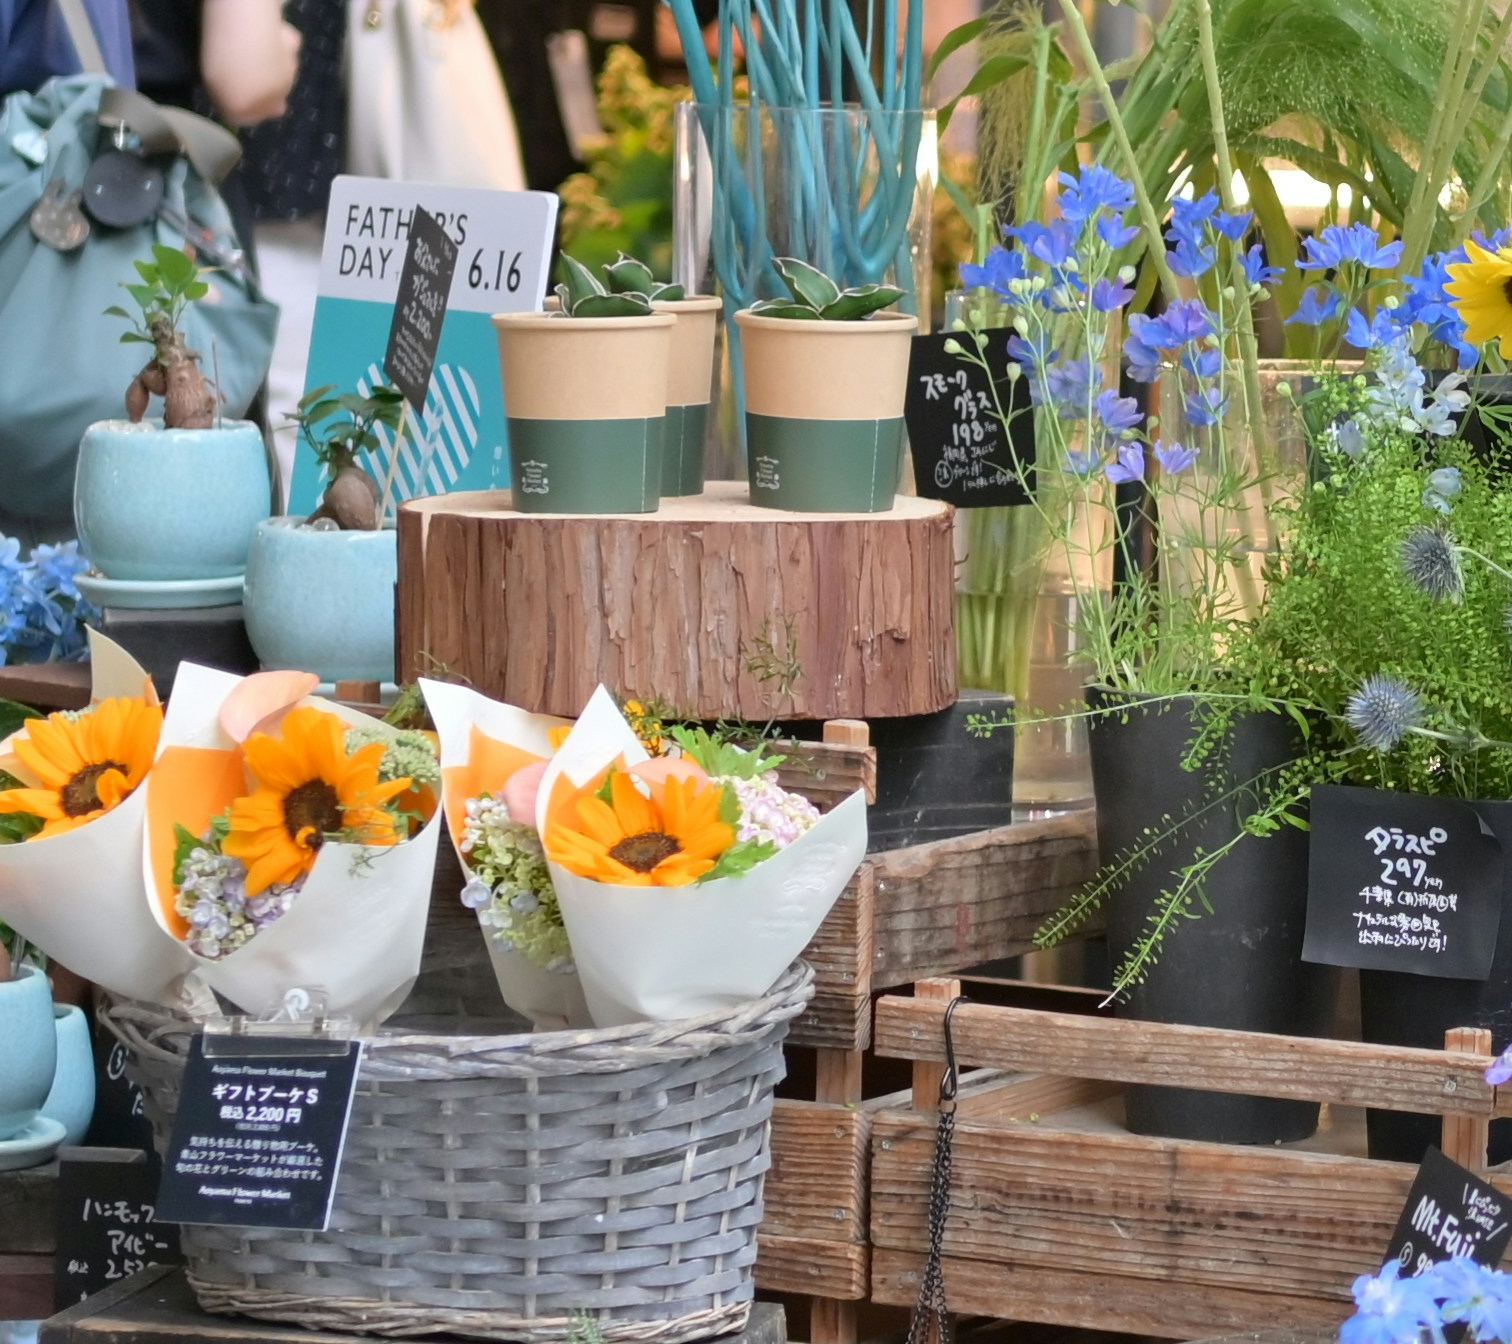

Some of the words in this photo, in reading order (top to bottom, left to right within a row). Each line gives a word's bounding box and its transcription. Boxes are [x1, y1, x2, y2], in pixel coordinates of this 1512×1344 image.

[339, 244, 394, 281] DAY
[467, 248, 523, 293] 6.16
[920, 370, 967, 400] スモーク
[954, 389, 992, 420] グラス
[952, 420, 984, 447] 198
[1364, 826, 1448, 856] タラスピ
[1380, 857, 1427, 887] 297
[1425, 876, 1443, 890] yen
[82, 1198, 156, 1223] ハンモック
[107, 1230, 168, 1255] アイビー
